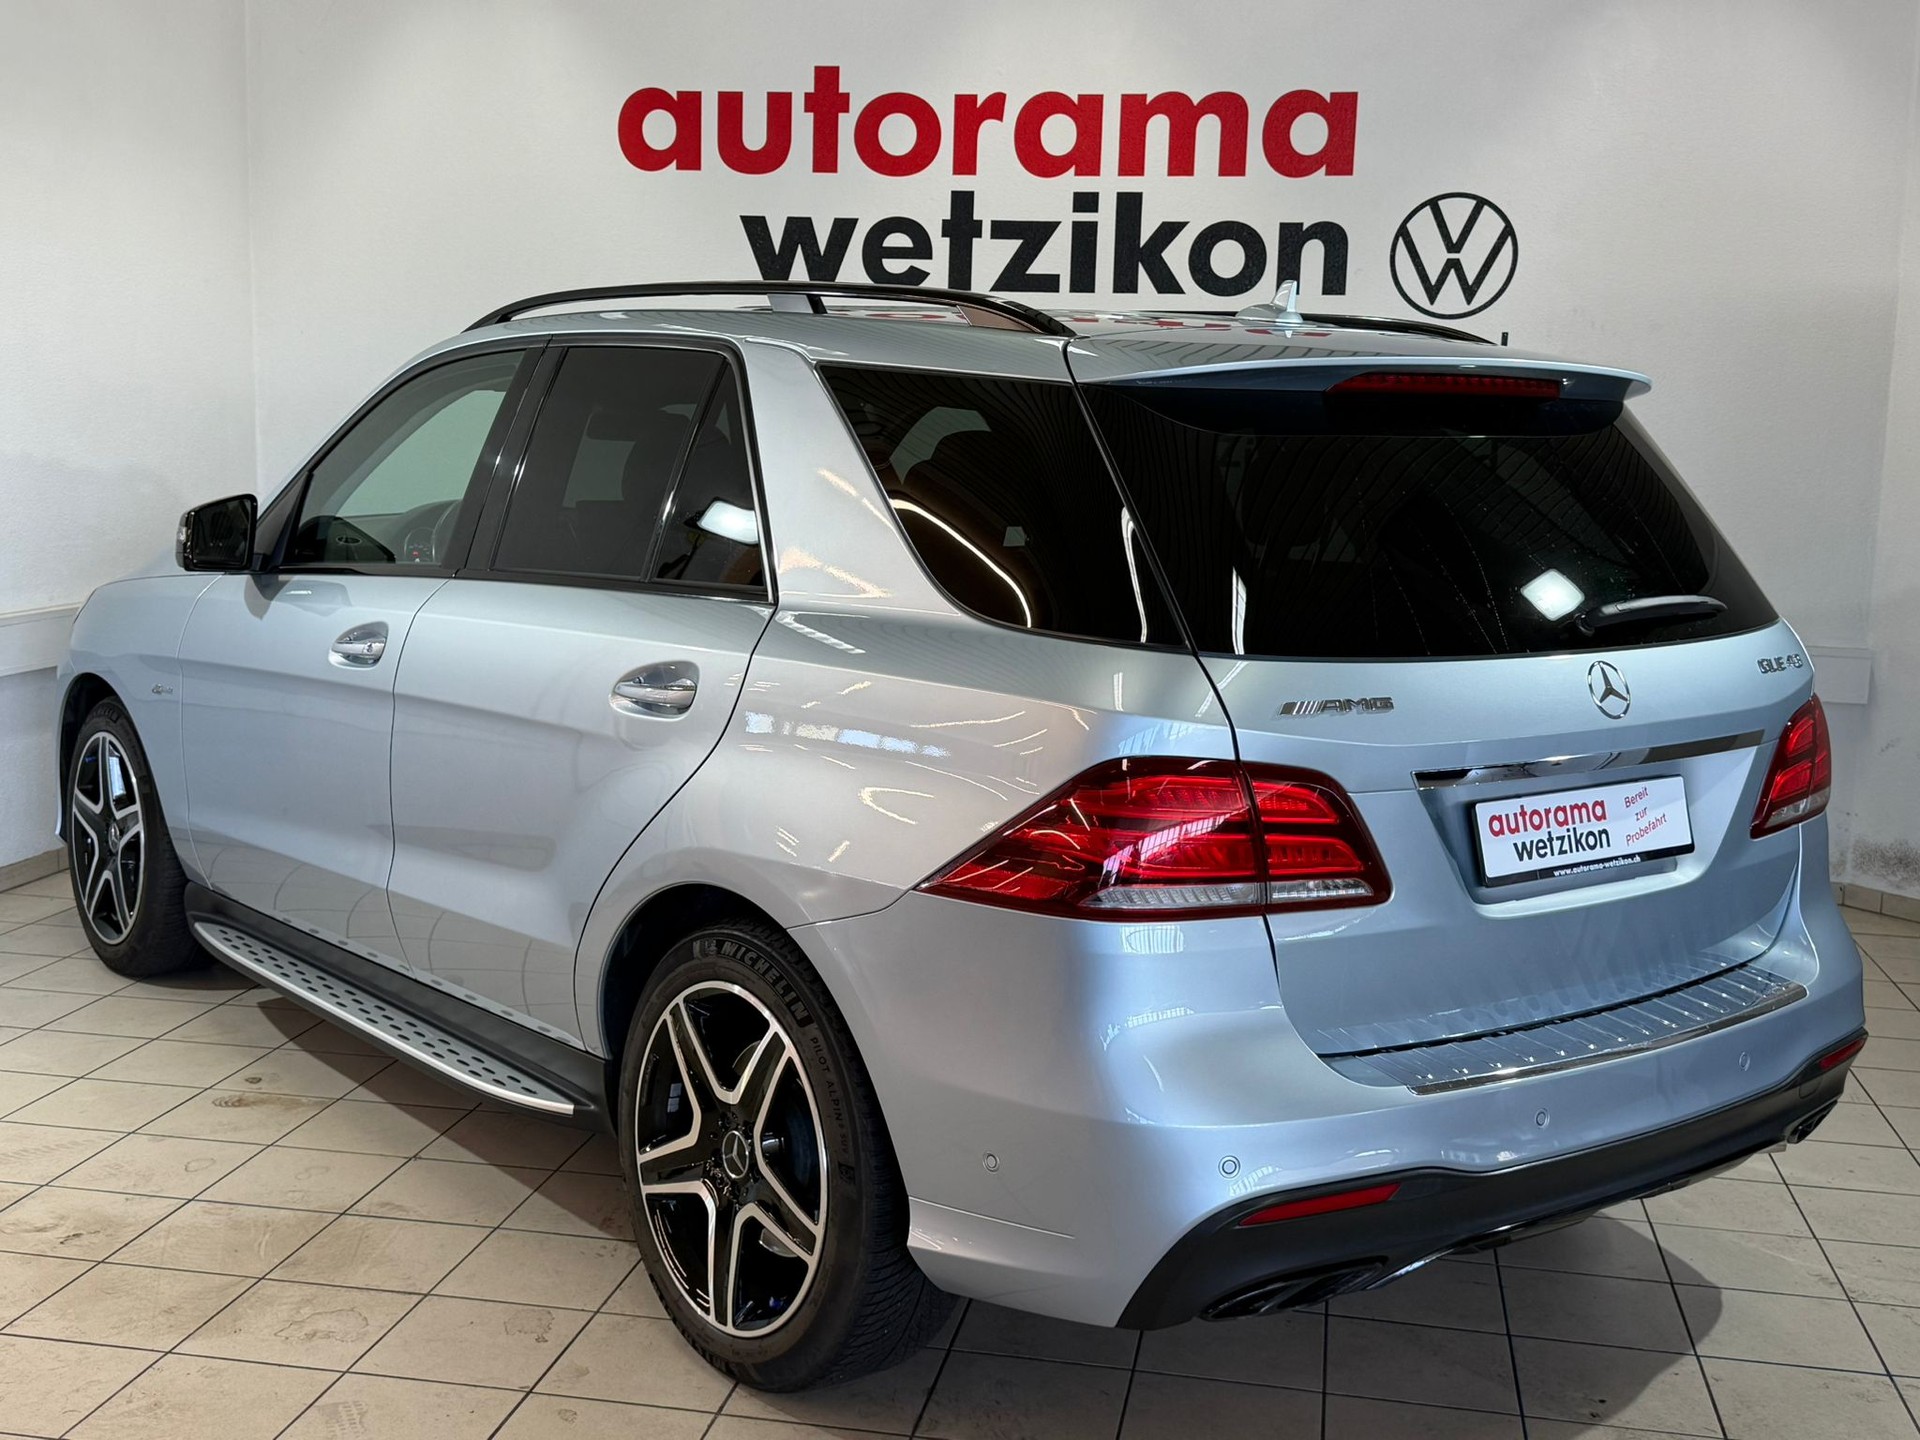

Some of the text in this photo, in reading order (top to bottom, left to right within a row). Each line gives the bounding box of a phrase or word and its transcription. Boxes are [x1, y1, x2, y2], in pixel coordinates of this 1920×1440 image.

[618, 66, 1359, 178] autorama
[740, 192, 1349, 296] wetzikon
[1319, 696, 1395, 714] AMG
[1624, 786, 1649, 808] Bereit
[1635, 806, 1648, 822] zur
[1488, 799, 1607, 837] autorama
[1625, 812, 1667, 847] Probefahrt
[1513, 828, 1611, 862] wetzikon
[1553, 856, 1641, 877] www.autorama-wetzikon.ch
[720, 941, 809, 1020] MICHELIN
[810, 1037, 829, 1072] PILOT
[826, 1080, 843, 1121] ALPIN
